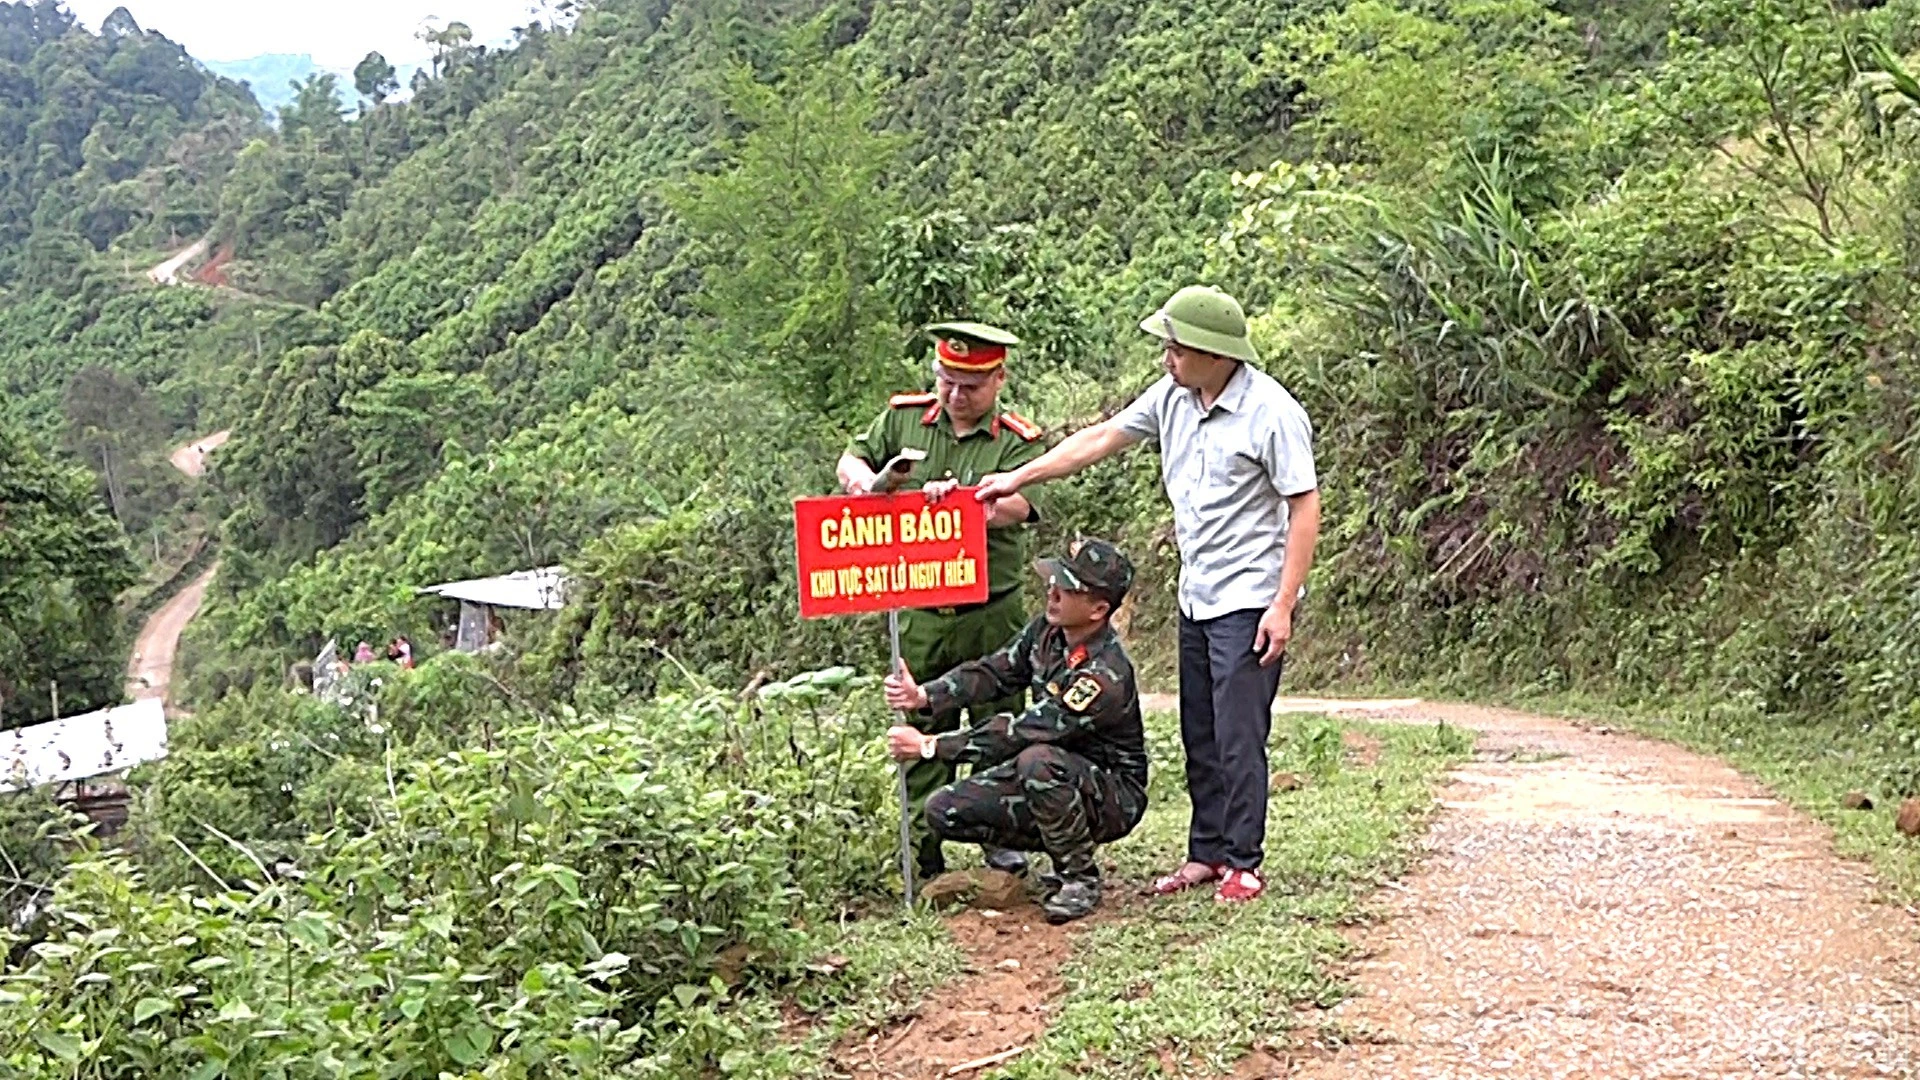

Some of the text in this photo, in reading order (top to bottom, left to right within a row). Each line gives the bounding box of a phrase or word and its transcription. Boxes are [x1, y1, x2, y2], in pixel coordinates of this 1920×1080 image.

[821, 505, 962, 549] CẢNH BÁO!
[810, 570, 836, 598] KHU
[837, 565, 863, 600] VỰC
[865, 564, 888, 600] SẠT
[891, 555, 907, 592] LỞ
[909, 561, 942, 590] NGUY
